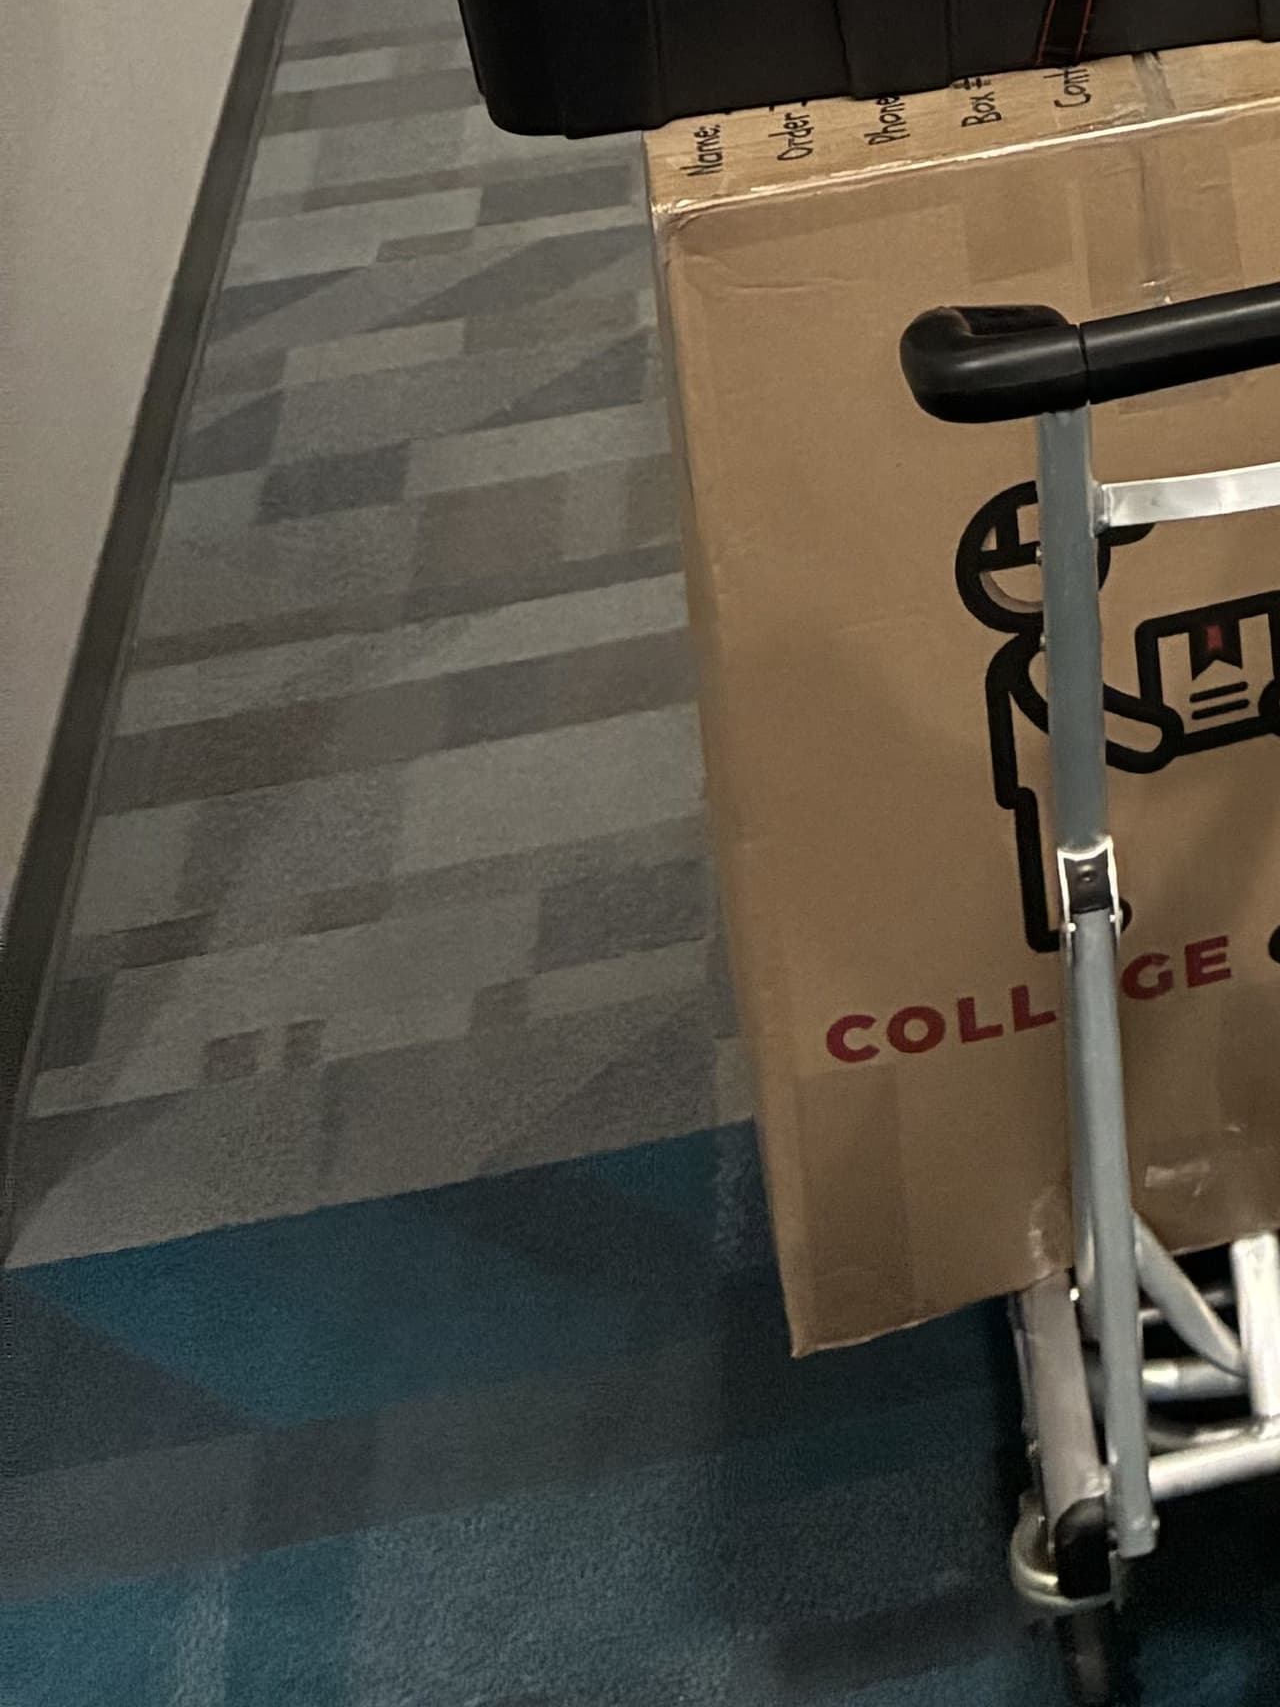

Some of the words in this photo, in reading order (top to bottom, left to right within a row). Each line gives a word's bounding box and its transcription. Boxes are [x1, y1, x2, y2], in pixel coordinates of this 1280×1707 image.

[961, 91, 1002, 127] Box
[1043, 67, 1092, 108] Cont
[681, 124, 724, 176] Name:
[768, 112, 815, 161] Order
[825, 935, 1231, 1065] COLLGE
